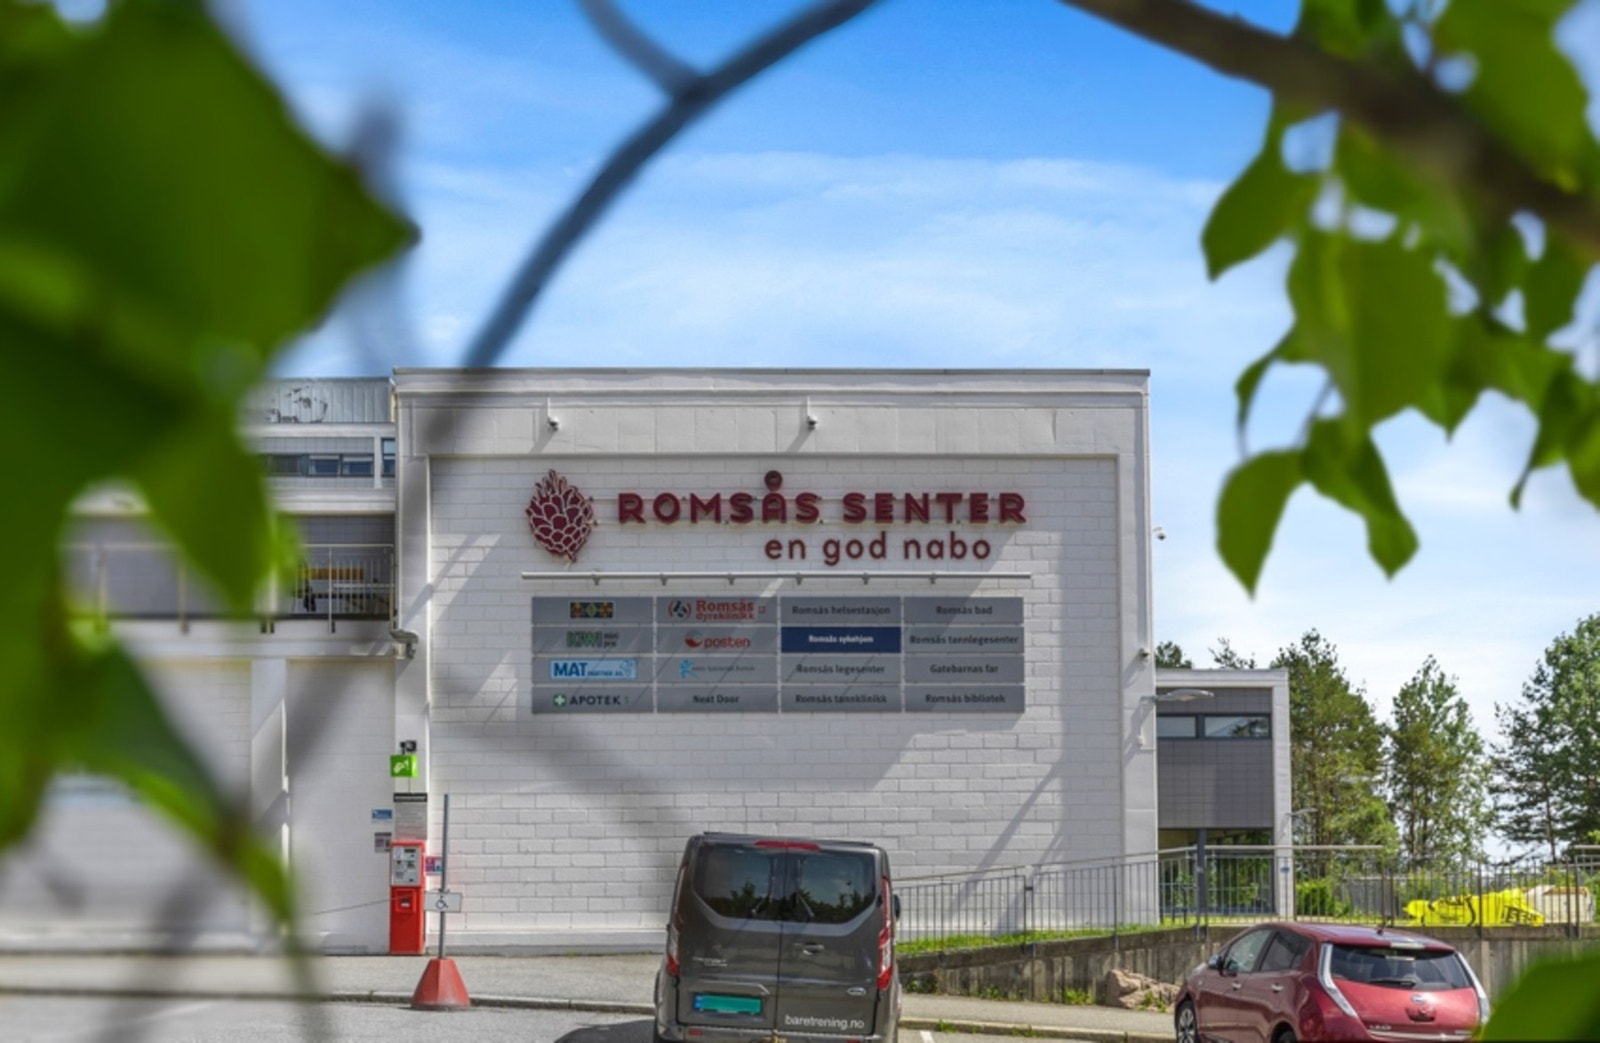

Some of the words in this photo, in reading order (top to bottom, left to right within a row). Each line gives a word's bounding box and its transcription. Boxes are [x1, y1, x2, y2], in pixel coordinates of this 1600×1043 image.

[618, 470, 821, 524] ROMSÅS
[842, 492, 1028, 524] SENTER
[765, 536, 806, 560] en
[823, 532, 887, 566] god
[903, 531, 991, 560] nabo
[695, 599, 754, 611] Romsås
[791, 605, 829, 615] Romsås
[831, 605, 891, 617] helsestasjon
[936, 605, 973, 615] Romsås
[974, 605, 993, 615] bad
[703, 636, 751, 650] posten
[909, 634, 946, 645] Romsås
[947, 634, 1019, 647] tannlegesenter
[554, 662, 588, 677] MAT
[796, 664, 833, 674] Romsås
[835, 664, 885, 676] legesenter
[930, 664, 983, 674] Gatebarnas
[985, 664, 999, 674] far
[570, 695, 621, 705] APOTEK
[716, 695, 740, 704] Door
[795, 694, 832, 704] Romsås
[925, 694, 962, 704] Romsås
[964, 694, 1006, 704] bibliotek
[784, 1013, 866, 1030] baretrening.no
